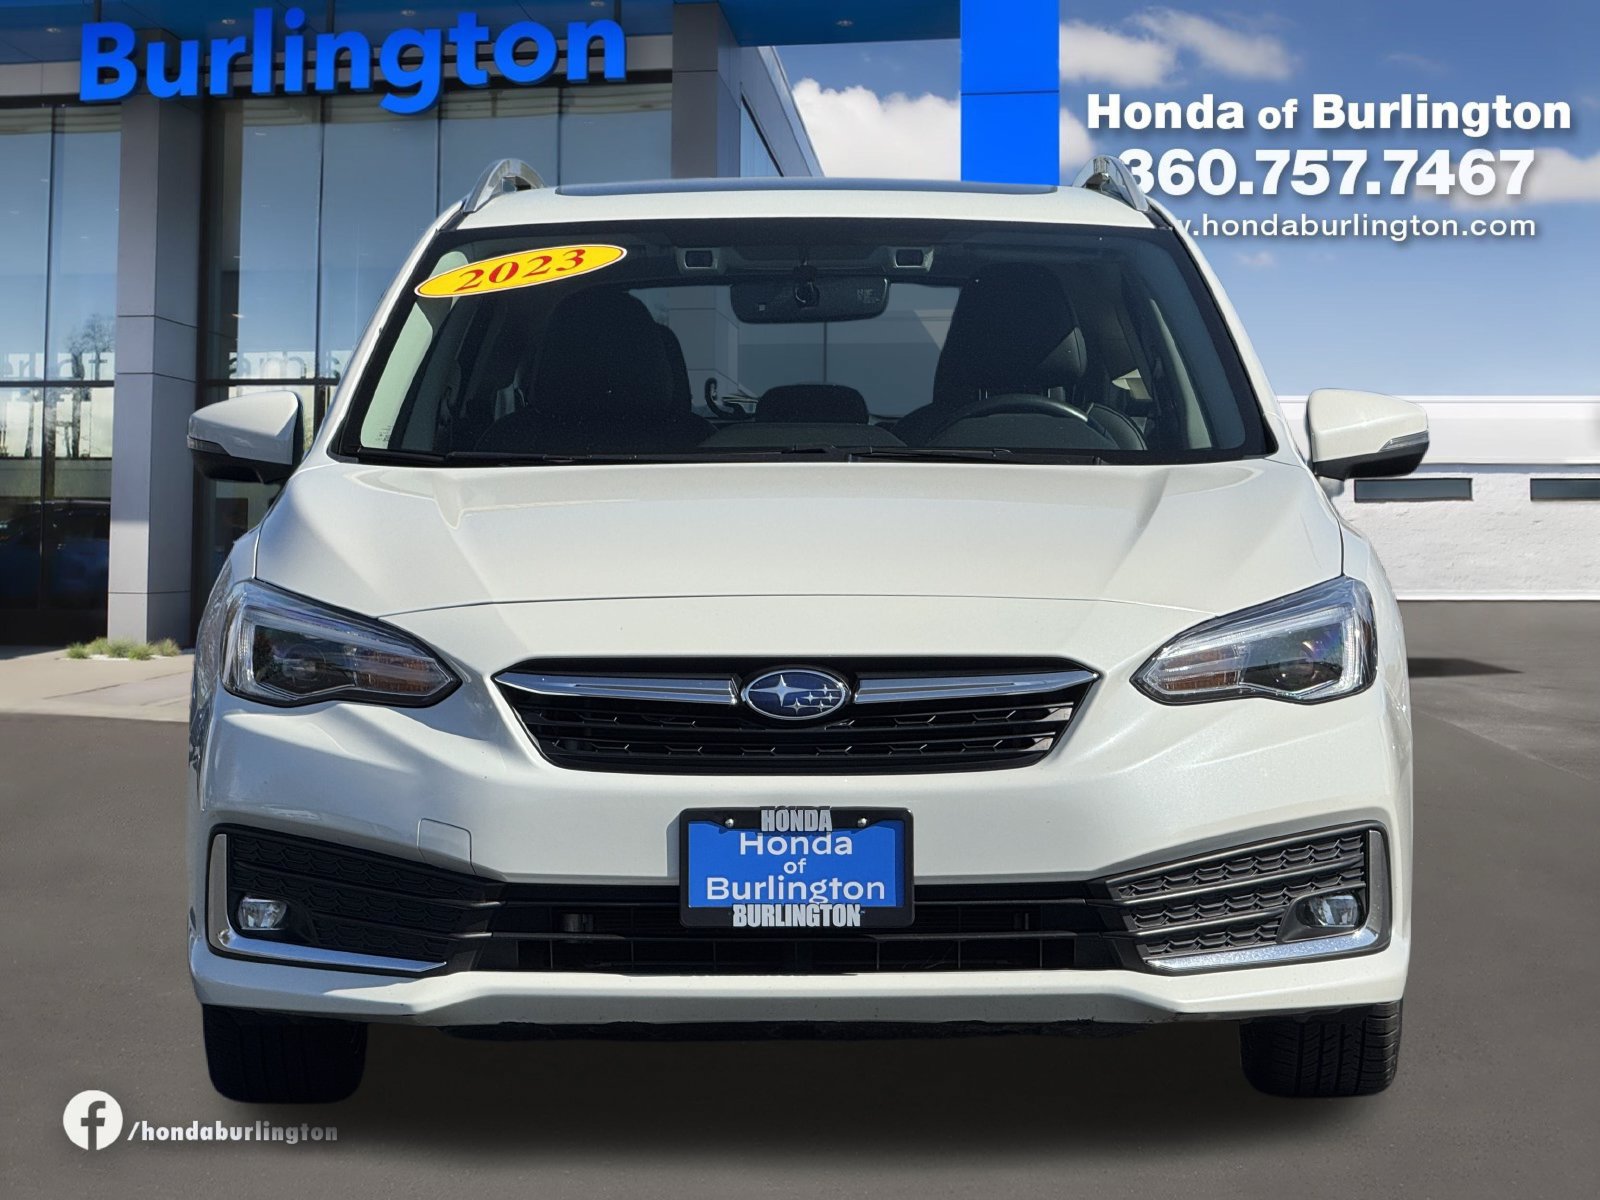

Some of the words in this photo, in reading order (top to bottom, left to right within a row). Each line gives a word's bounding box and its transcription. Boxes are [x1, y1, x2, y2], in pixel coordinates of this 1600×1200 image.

[80, 7, 627, 114] Burlington
[453, 248, 587, 293] 2023
[760, 806, 833, 832] HONDA
[739, 832, 854, 856] Honda
[783, 858, 807, 875] of
[706, 875, 886, 904] Burlington
[732, 903, 861, 928] BURLINGTON
